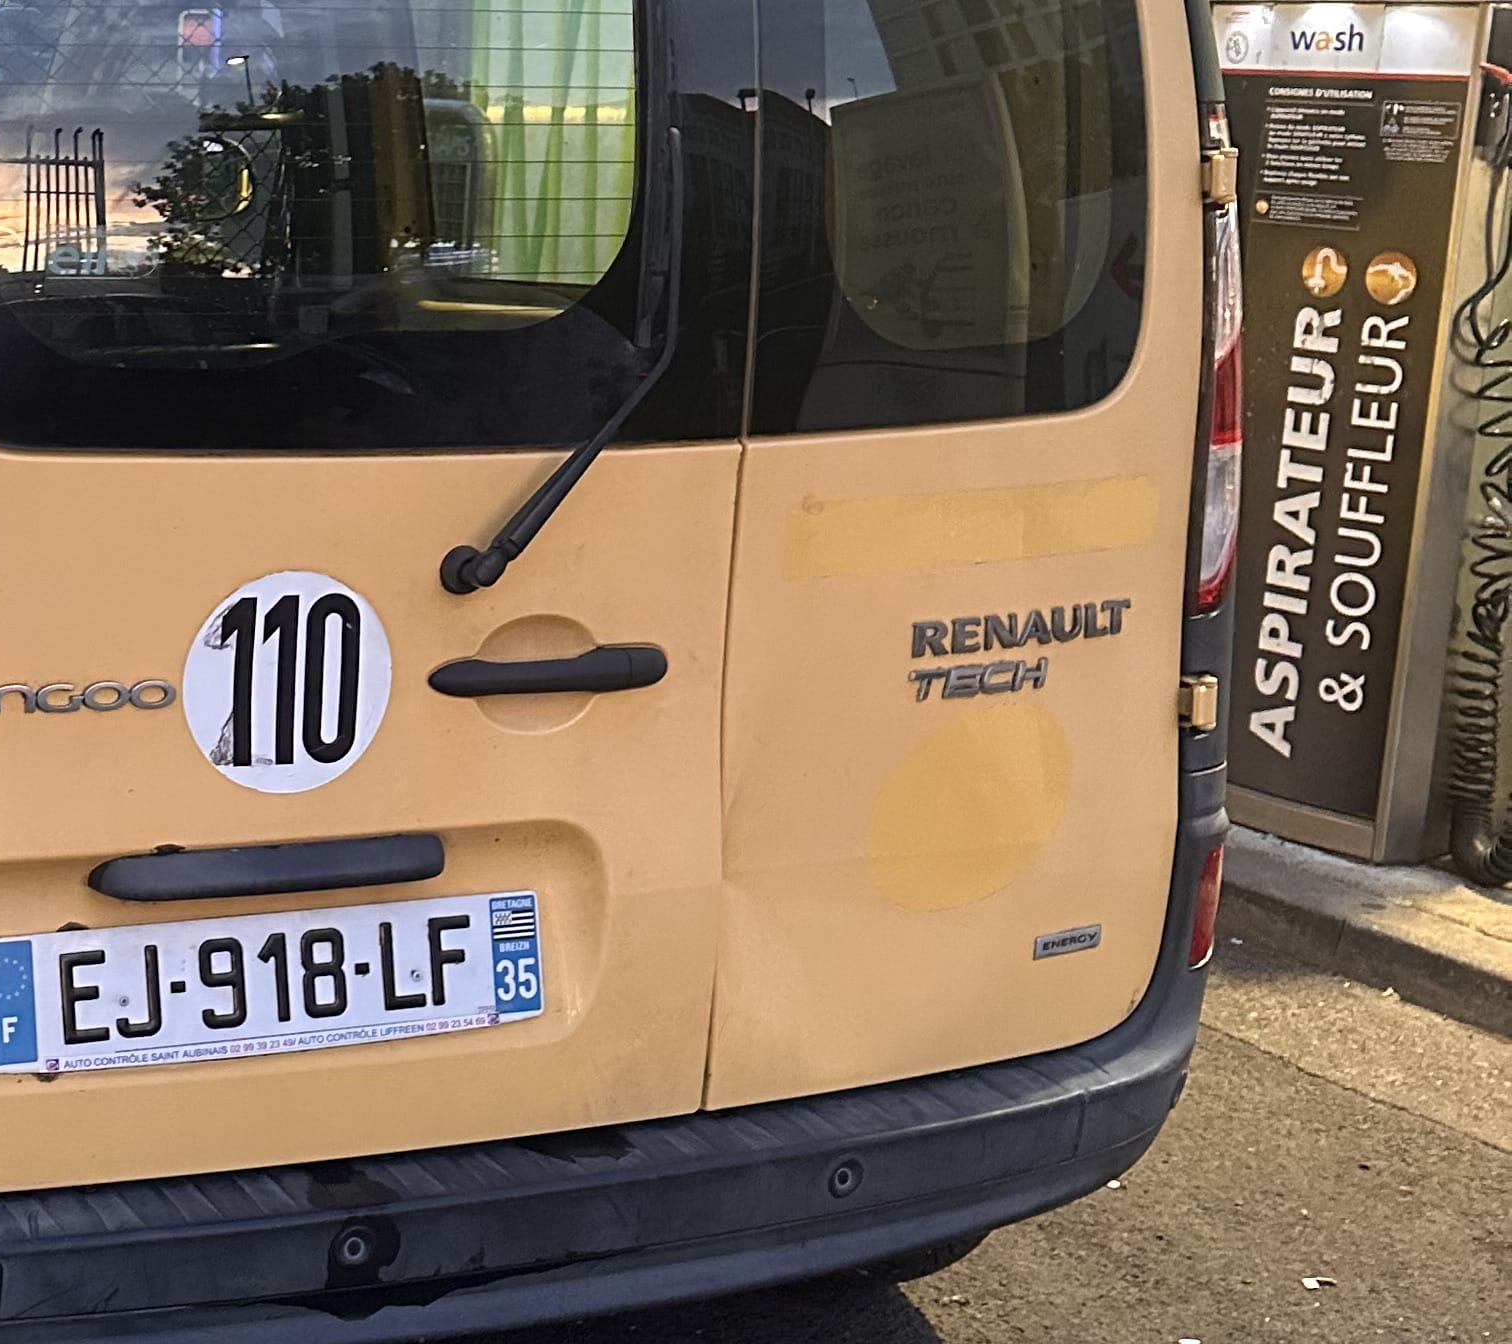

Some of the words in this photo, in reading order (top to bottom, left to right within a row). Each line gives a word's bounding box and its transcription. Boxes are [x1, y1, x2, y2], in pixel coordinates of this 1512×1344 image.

[1290, 24, 1365, 52] wash
[1269, 87, 1314, 97] CONSIGNES
[1325, 313, 1410, 651] SOUFFLEUR
[1248, 305, 1344, 758] ASPIRATEUR
[911, 598, 1132, 659] RENAULT
[221, 593, 361, 767] 110
[908, 656, 1049, 703] TECH
[1318, 672, 1367, 713] &
[491, 898, 533, 911] BRETAGNE
[1042, 932, 1098, 951] ENERGY
[59, 914, 471, 1046] EJ-918-LF
[495, 957, 538, 1002] 35
[1, 1016, 18, 1044] F
[63, 1058, 92, 1069] AUTO
[94, 1053, 149, 1067] CONTRÔLE
[151, 1051, 180, 1063] SAINT
[182, 1046, 228, 1059] AUBINAIS
[298, 1035, 324, 1046] AUTO
[326, 1029, 377, 1043] CONTRÔLE
[379, 1024, 425, 1037] LIFFREEN
